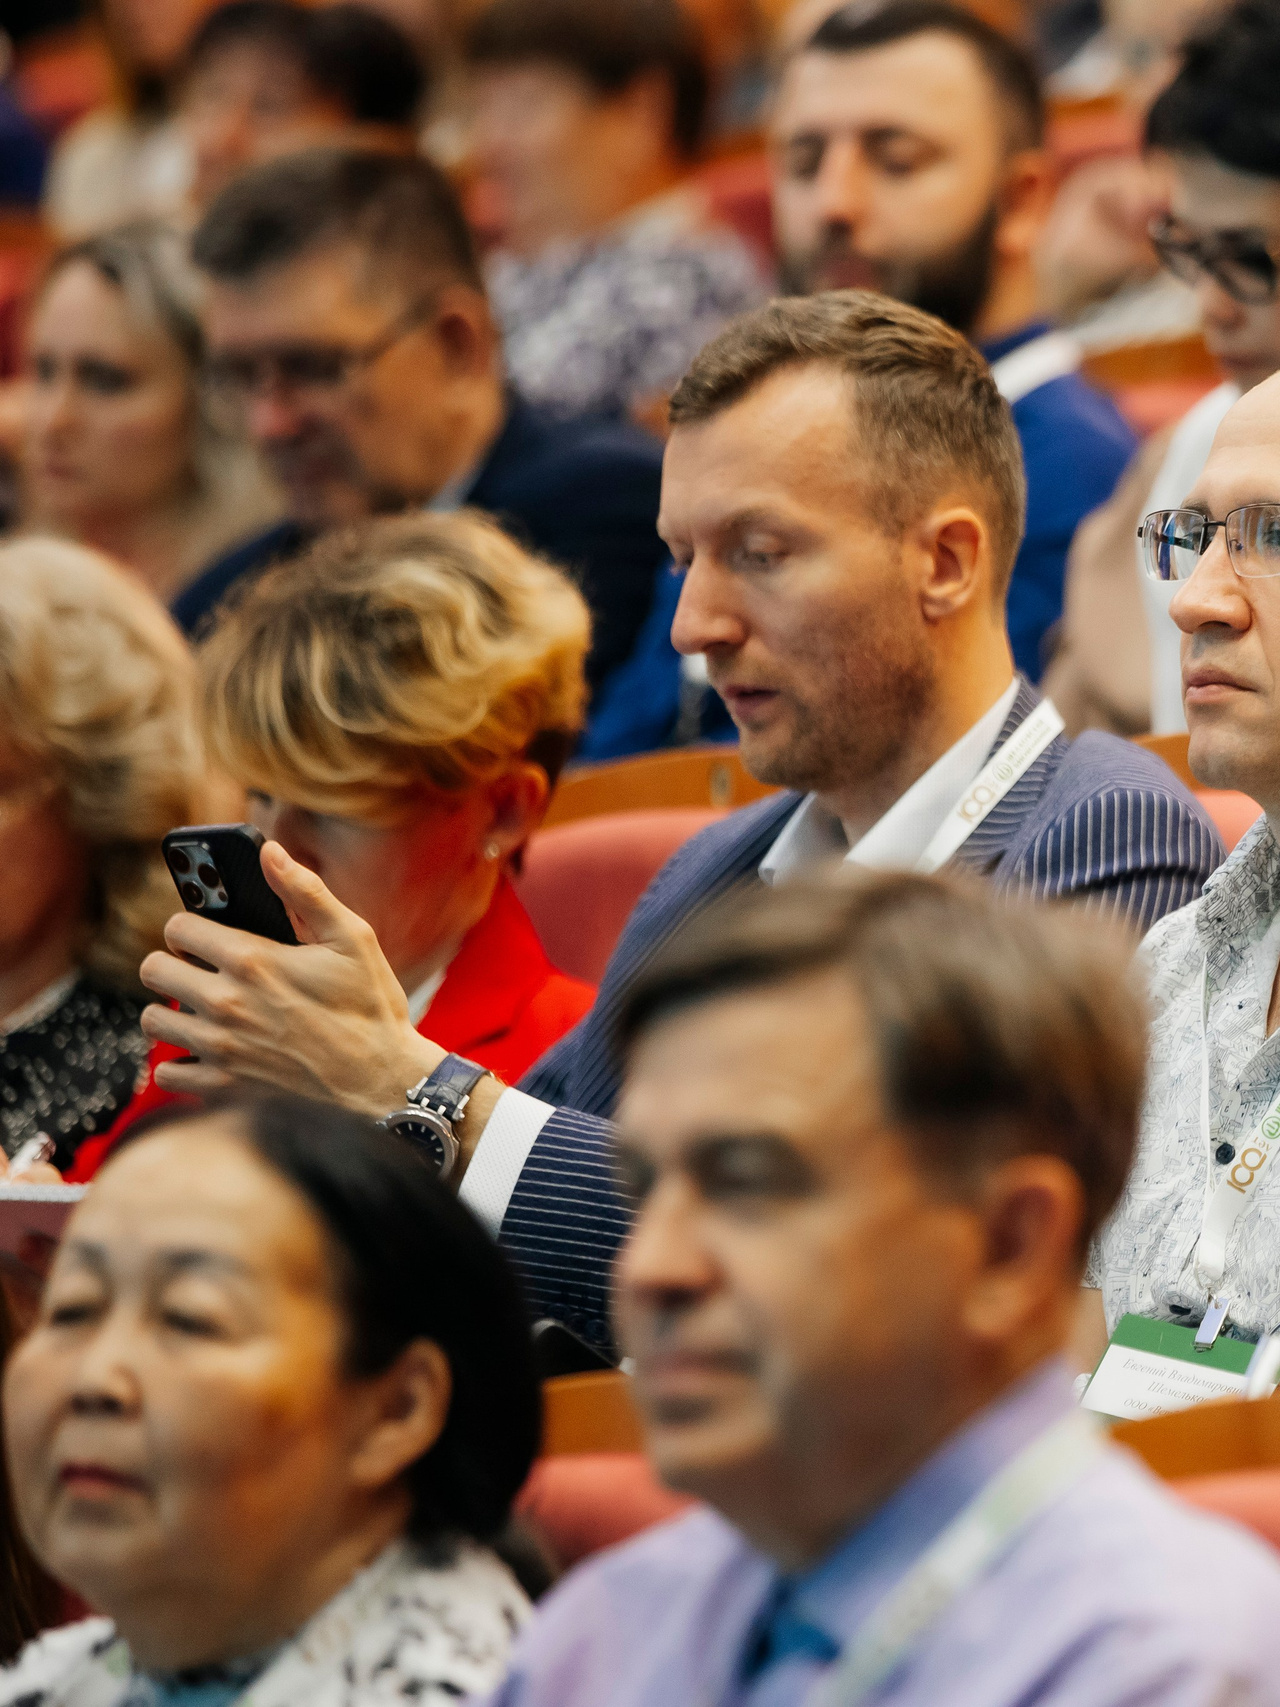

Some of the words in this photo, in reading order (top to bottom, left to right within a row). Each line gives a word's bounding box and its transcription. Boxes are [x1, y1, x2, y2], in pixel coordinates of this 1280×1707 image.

[1227, 1148, 1267, 1194] 100
[1122, 1358, 1167, 1377] Евгений
[1168, 1369, 1243, 1394] Владимирови
